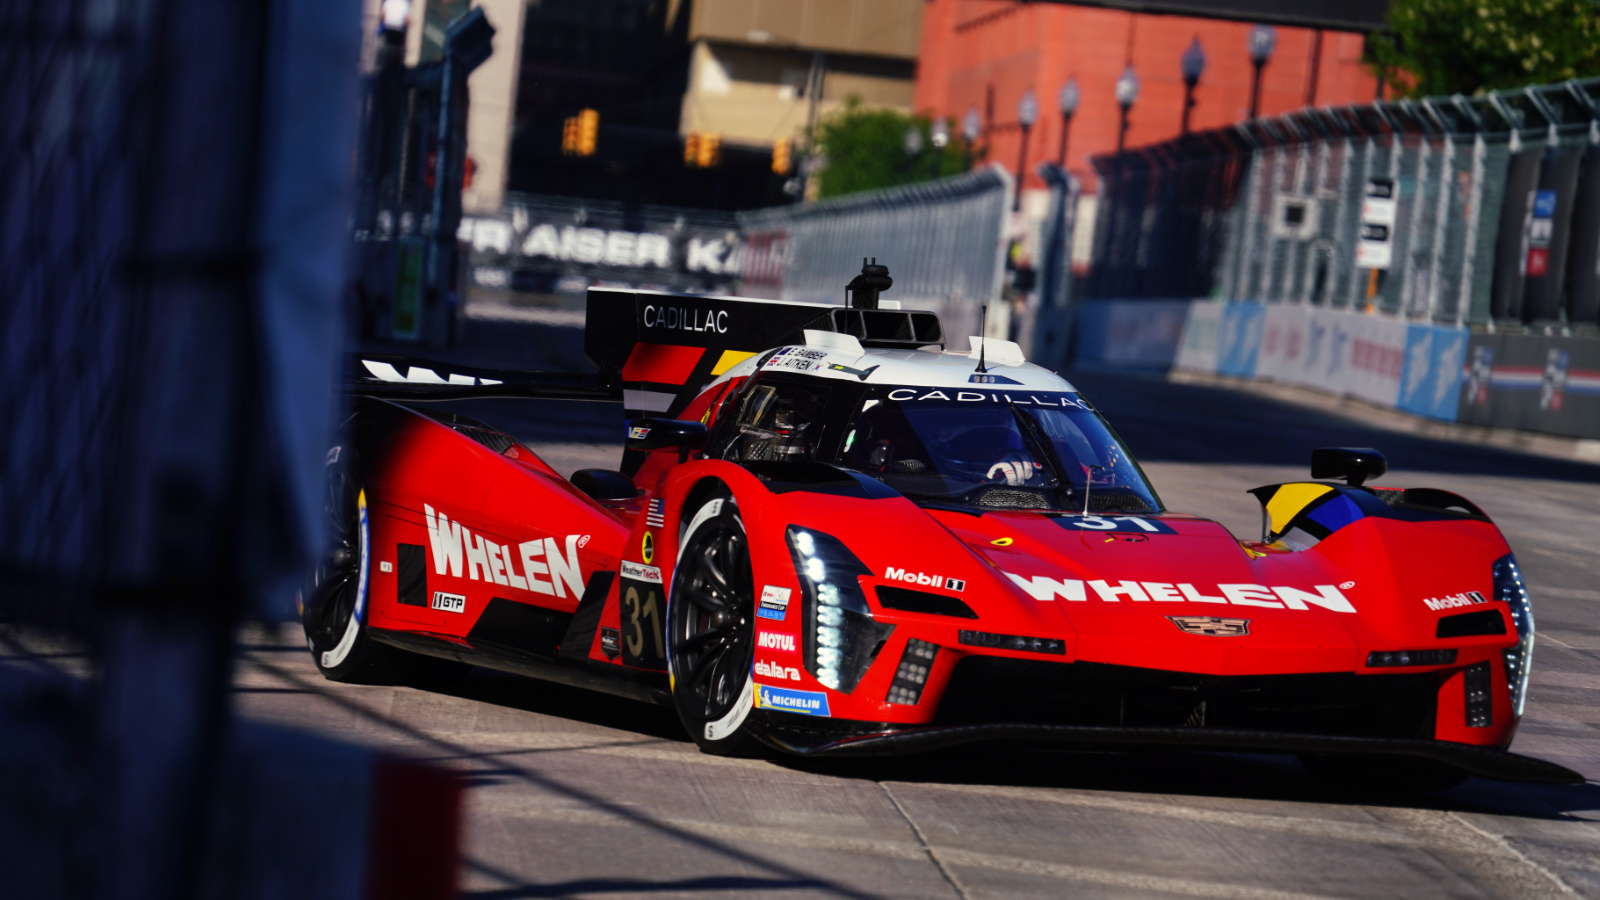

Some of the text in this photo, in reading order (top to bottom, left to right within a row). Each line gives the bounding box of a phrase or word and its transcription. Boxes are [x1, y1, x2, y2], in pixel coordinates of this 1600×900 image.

[643, 304, 729, 334] CADILLAC
[783, 358, 813, 371] AITKEN
[887, 388, 1095, 412] CADILLAC
[1061, 514, 1160, 532] 31
[423, 502, 587, 602] WHELEN
[884, 566, 943, 588] Mobil
[1002, 570, 1357, 613] WHELEN
[1422, 593, 1472, 611] Mobil
[442, 596, 463, 610] GTP
[625, 586, 665, 659] 31
[757, 631, 796, 652] MOTUL
[754, 659, 801, 681] dallara
[771, 694, 821, 709] MICHELIN
